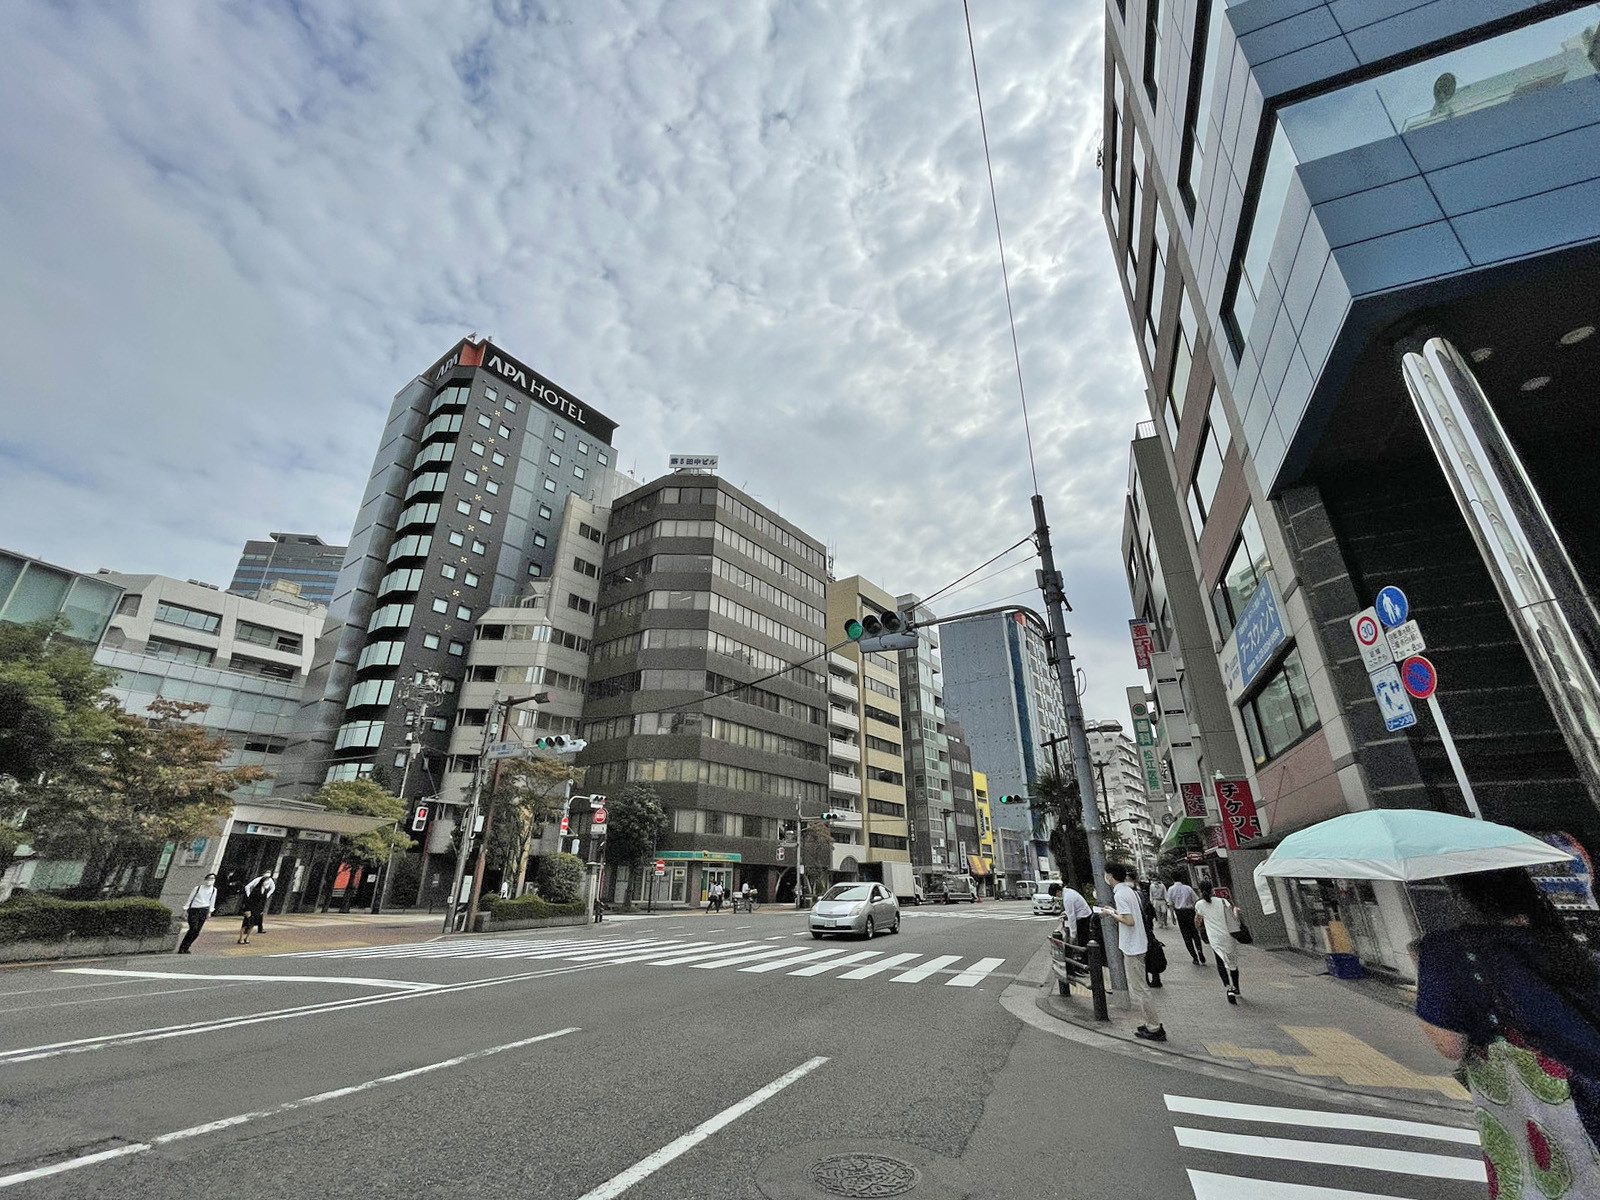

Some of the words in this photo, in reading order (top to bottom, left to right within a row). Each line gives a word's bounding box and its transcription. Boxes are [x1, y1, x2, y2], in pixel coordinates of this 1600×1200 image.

[436, 353, 459, 380] APA
[488, 355, 527, 388] APA
[530, 379, 586, 424] HOTEL
[1240, 599, 1274, 664] アースウィンド
[1361, 623, 1373, 639] 30
[1368, 653, 1388, 667] ここから
[1221, 783, 1252, 846] チケット
